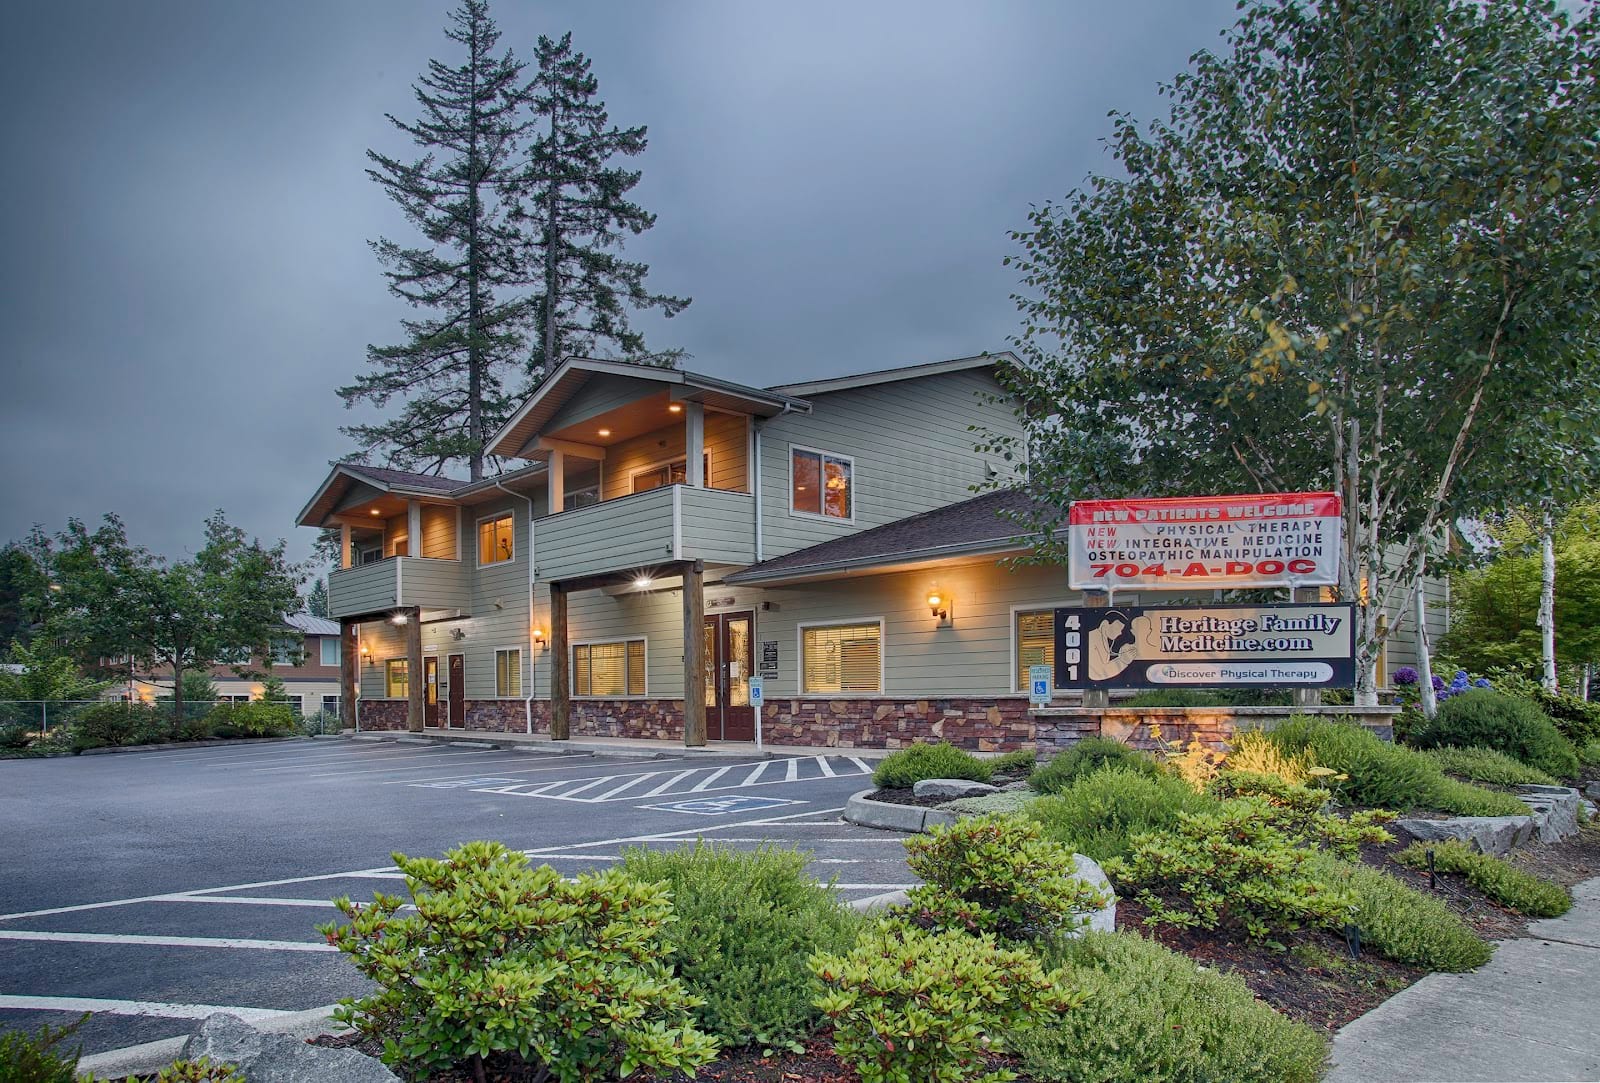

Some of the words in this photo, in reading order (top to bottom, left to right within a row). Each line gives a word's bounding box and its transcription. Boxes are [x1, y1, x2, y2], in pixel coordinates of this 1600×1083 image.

[1093, 510, 1129, 522] NEW
[1135, 507, 1220, 520] PATIENTS
[1226, 503, 1315, 518] WELCOME
[1087, 527, 1117, 537] NEW
[1157, 523, 1235, 535] PHYSICAL
[1248, 520, 1322, 533] THERAPY
[1087, 540, 1117, 549] NEW
[1126, 536, 1229, 549] INTEGRATIVE
[1243, 533, 1322, 546] MEDICINE
[1088, 550, 1194, 561] OSTEOPATHIC
[1200, 546, 1322, 559] MANIPULATION
[1090, 559, 1316, 578] 704-A-DOC
[1160, 616, 1257, 636] Heritage
[1260, 614, 1342, 635] Family
[1064, 615, 1081, 681] 4001
[1160, 635, 1313, 652] Medicine.com
[1169, 670, 1216, 678] Discover
[1220, 670, 1268, 679] Physical
[1270, 669, 1317, 679] Therapy
